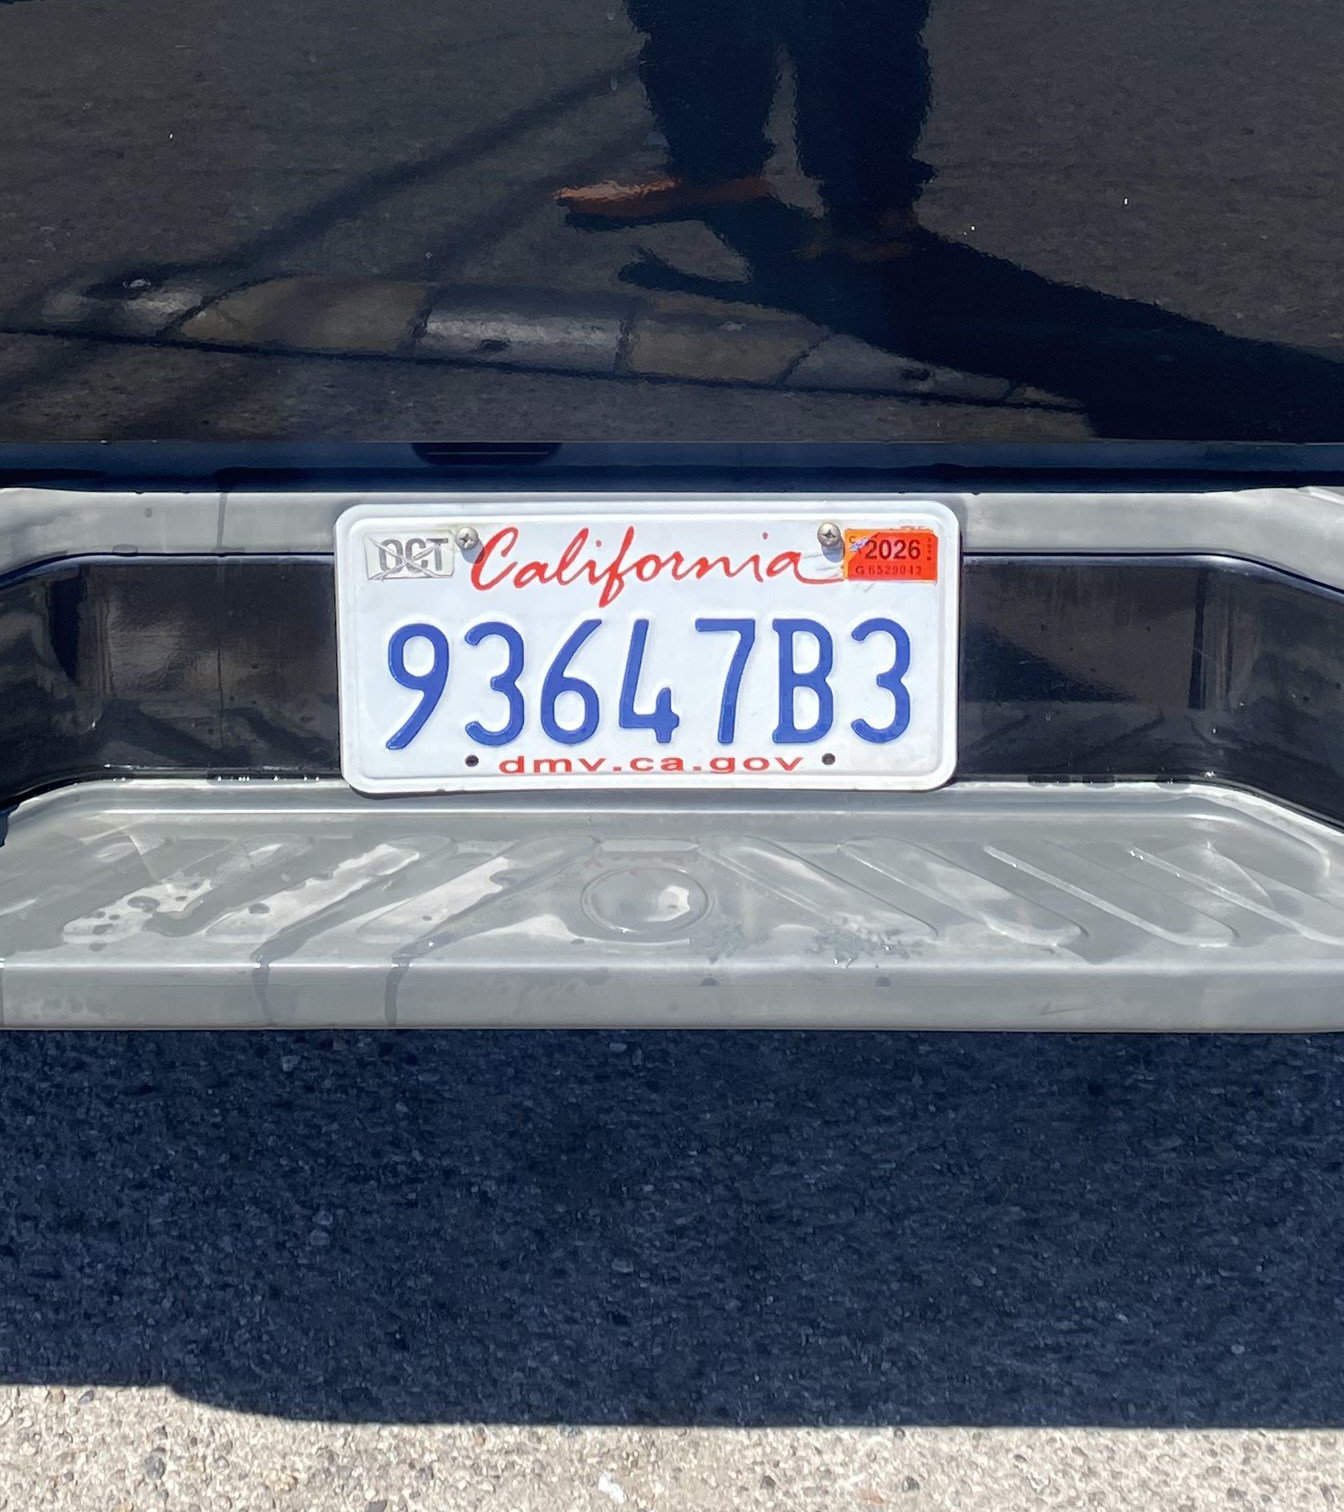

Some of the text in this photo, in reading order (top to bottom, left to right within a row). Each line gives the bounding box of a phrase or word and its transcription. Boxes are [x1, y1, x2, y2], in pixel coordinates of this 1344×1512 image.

[379, 538, 449, 574] OCT
[470, 525, 844, 609] California
[864, 539, 921, 560] 2026
[385, 617, 913, 751] 93647B3
[497, 753, 805, 775] dmv.ca.gov
